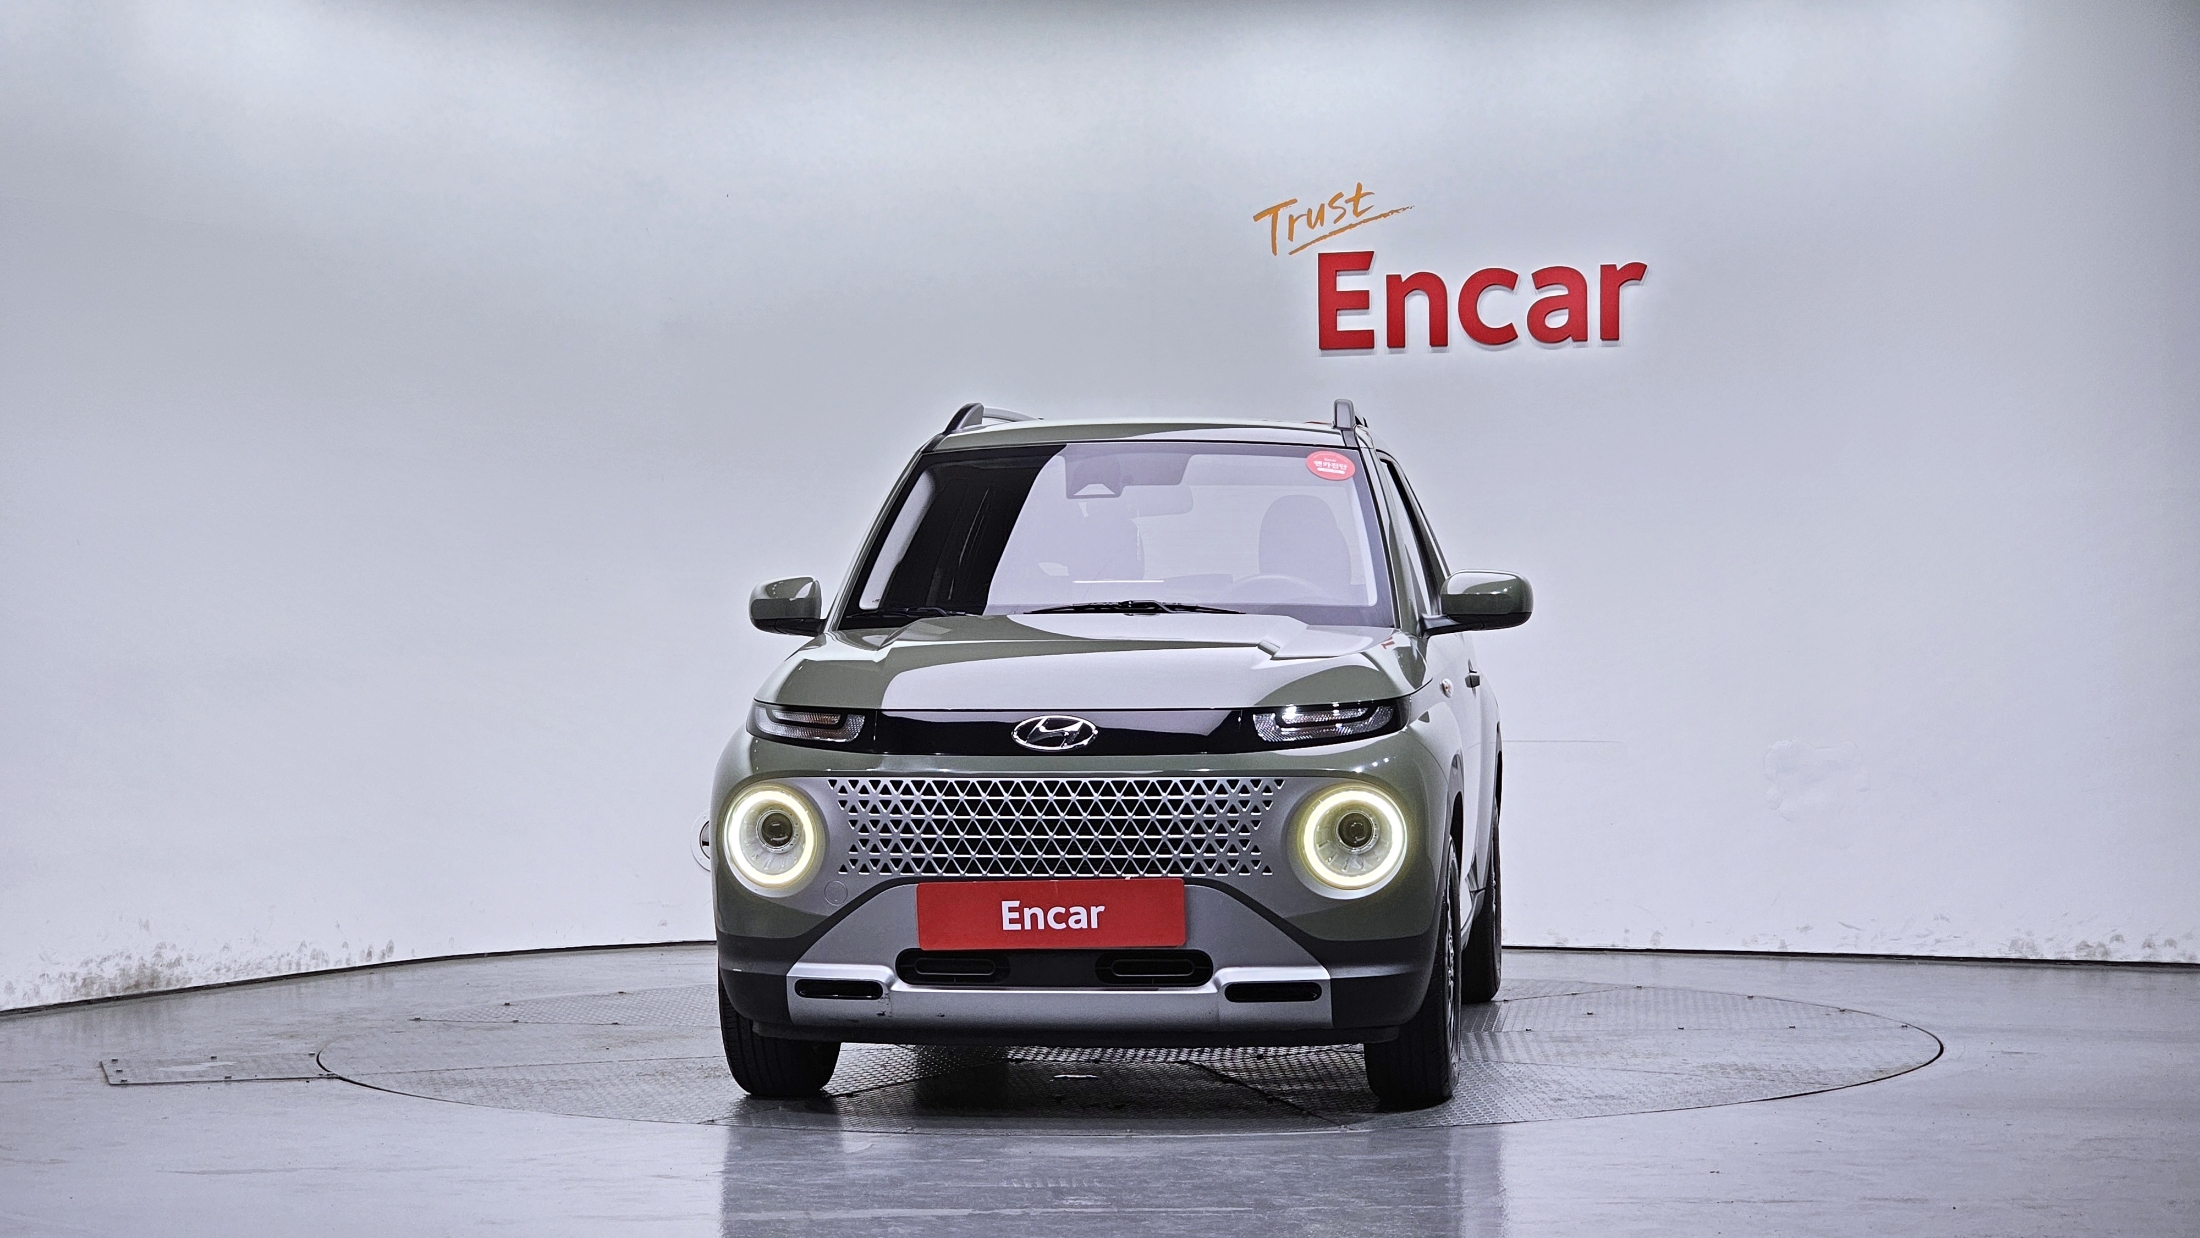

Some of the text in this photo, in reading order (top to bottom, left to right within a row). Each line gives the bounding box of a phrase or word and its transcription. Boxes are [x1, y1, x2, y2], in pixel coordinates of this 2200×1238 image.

[1253, 182, 1376, 256] Trust
[1317, 250, 1648, 350] Encar
[1001, 900, 1105, 931] Encar
